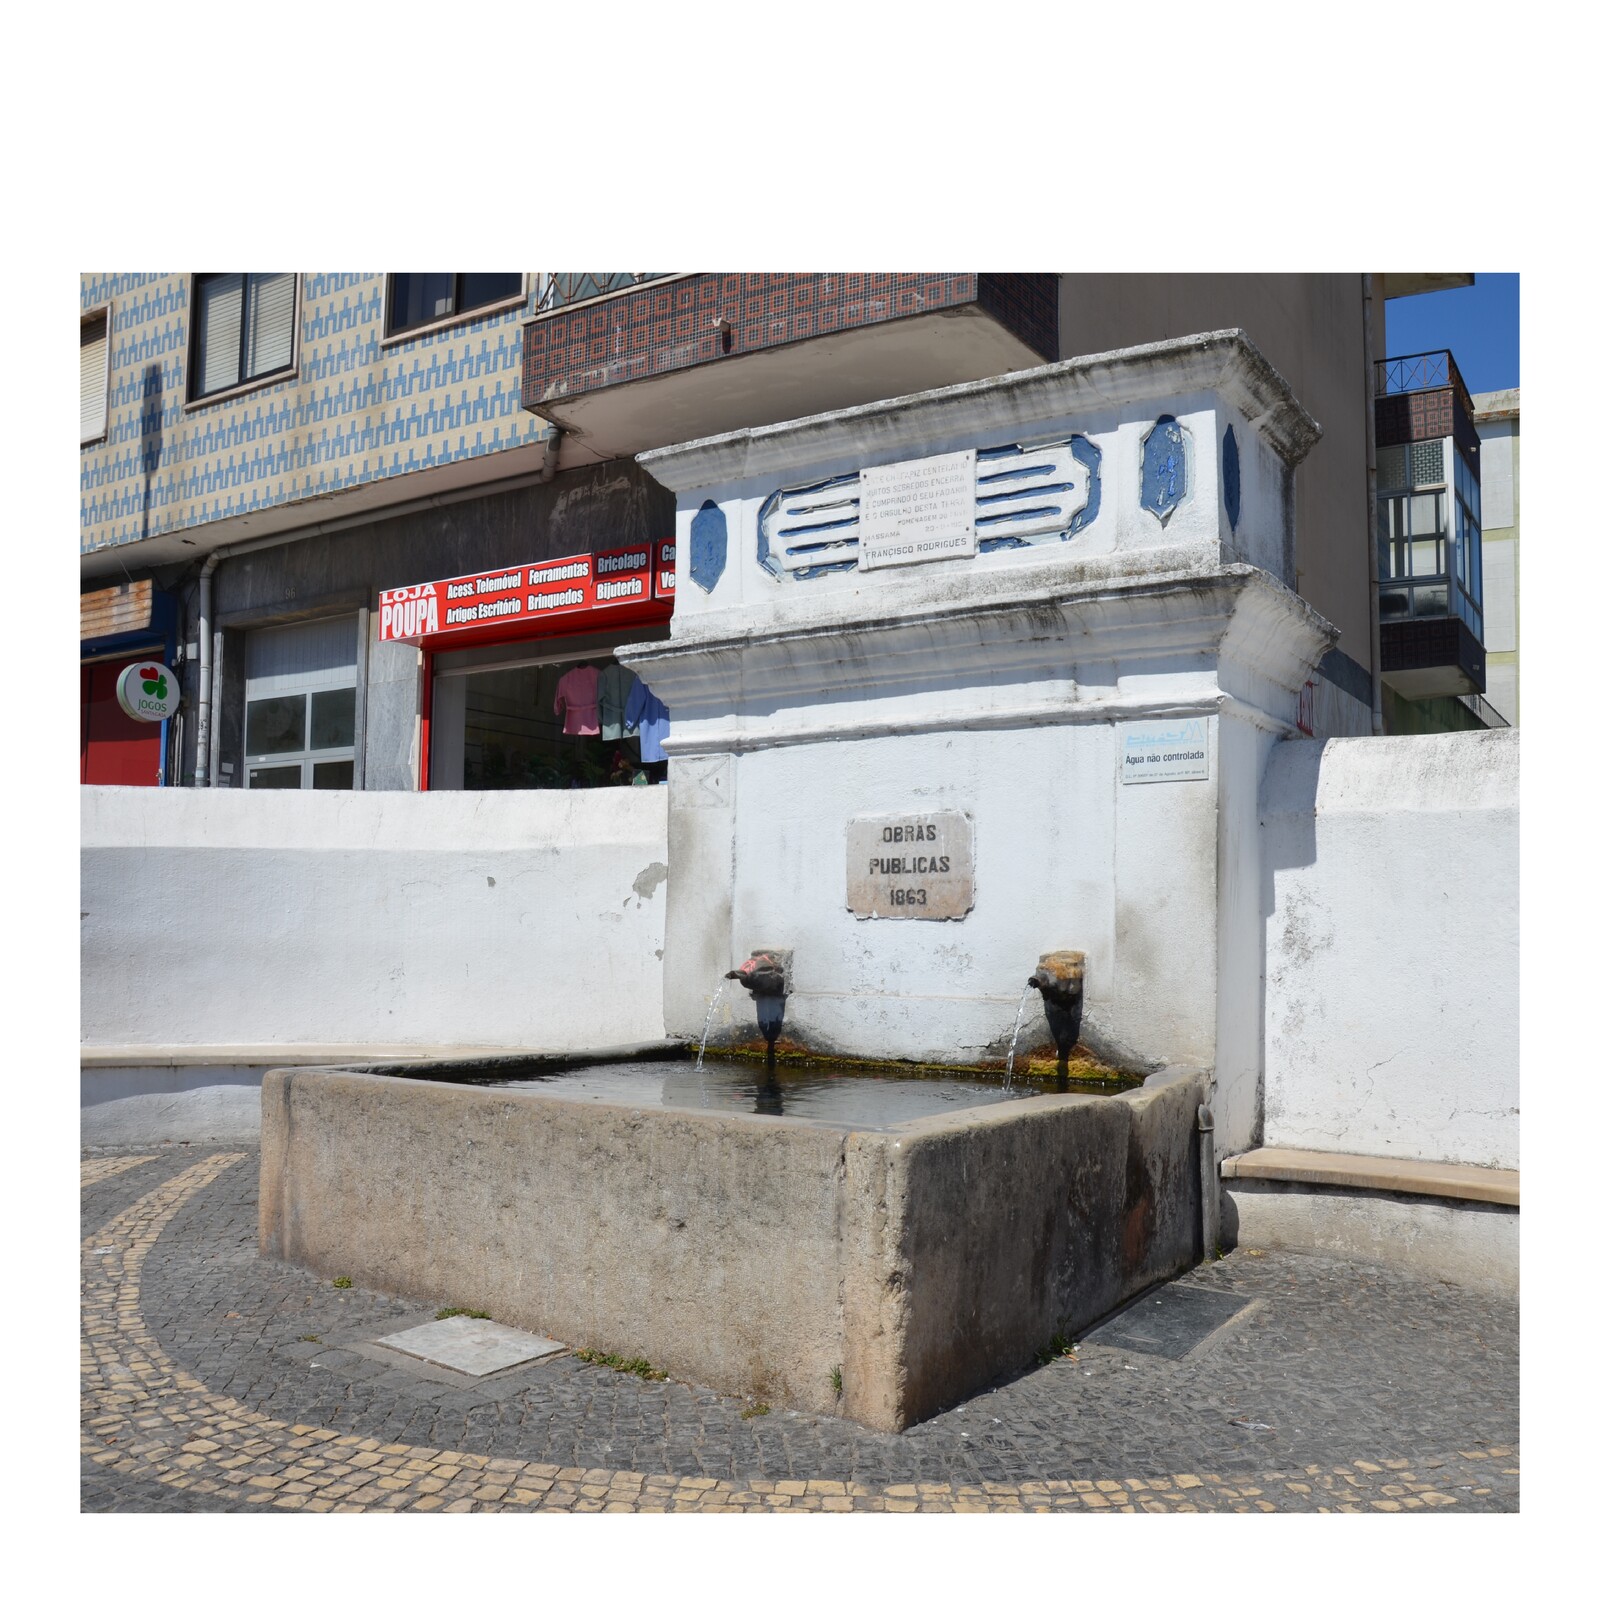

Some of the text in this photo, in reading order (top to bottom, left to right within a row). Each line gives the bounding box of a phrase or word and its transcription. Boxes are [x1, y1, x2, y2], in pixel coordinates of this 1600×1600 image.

[885, 469, 920, 481] CHFARIZ
[892, 480, 929, 492] SEGREDOS
[931, 475, 965, 486] ENCERRA
[872, 496, 911, 508] CUMPRINDO
[919, 491, 934, 501] SEU
[914, 502, 938, 513] DESTA
[916, 538, 967, 552] RODRIGUES
[597, 551, 647, 573] Bricolage
[528, 562, 589, 585] Ferramentas
[382, 584, 437, 604] LOJA
[446, 571, 522, 600] Acess. Telemóvel
[597, 577, 642, 600] Bijuteria
[527, 588, 584, 611] Brinquedos
[381, 596, 439, 640] POUPA
[446, 597, 522, 624] Artigos Escritório
[138, 699, 168, 713] JOGOS
[1125, 750, 1205, 766] Água não controlada
[882, 824, 937, 843] OBRAS
[869, 856, 950, 875] PUBLICAS
[890, 888, 927, 906] 1863
